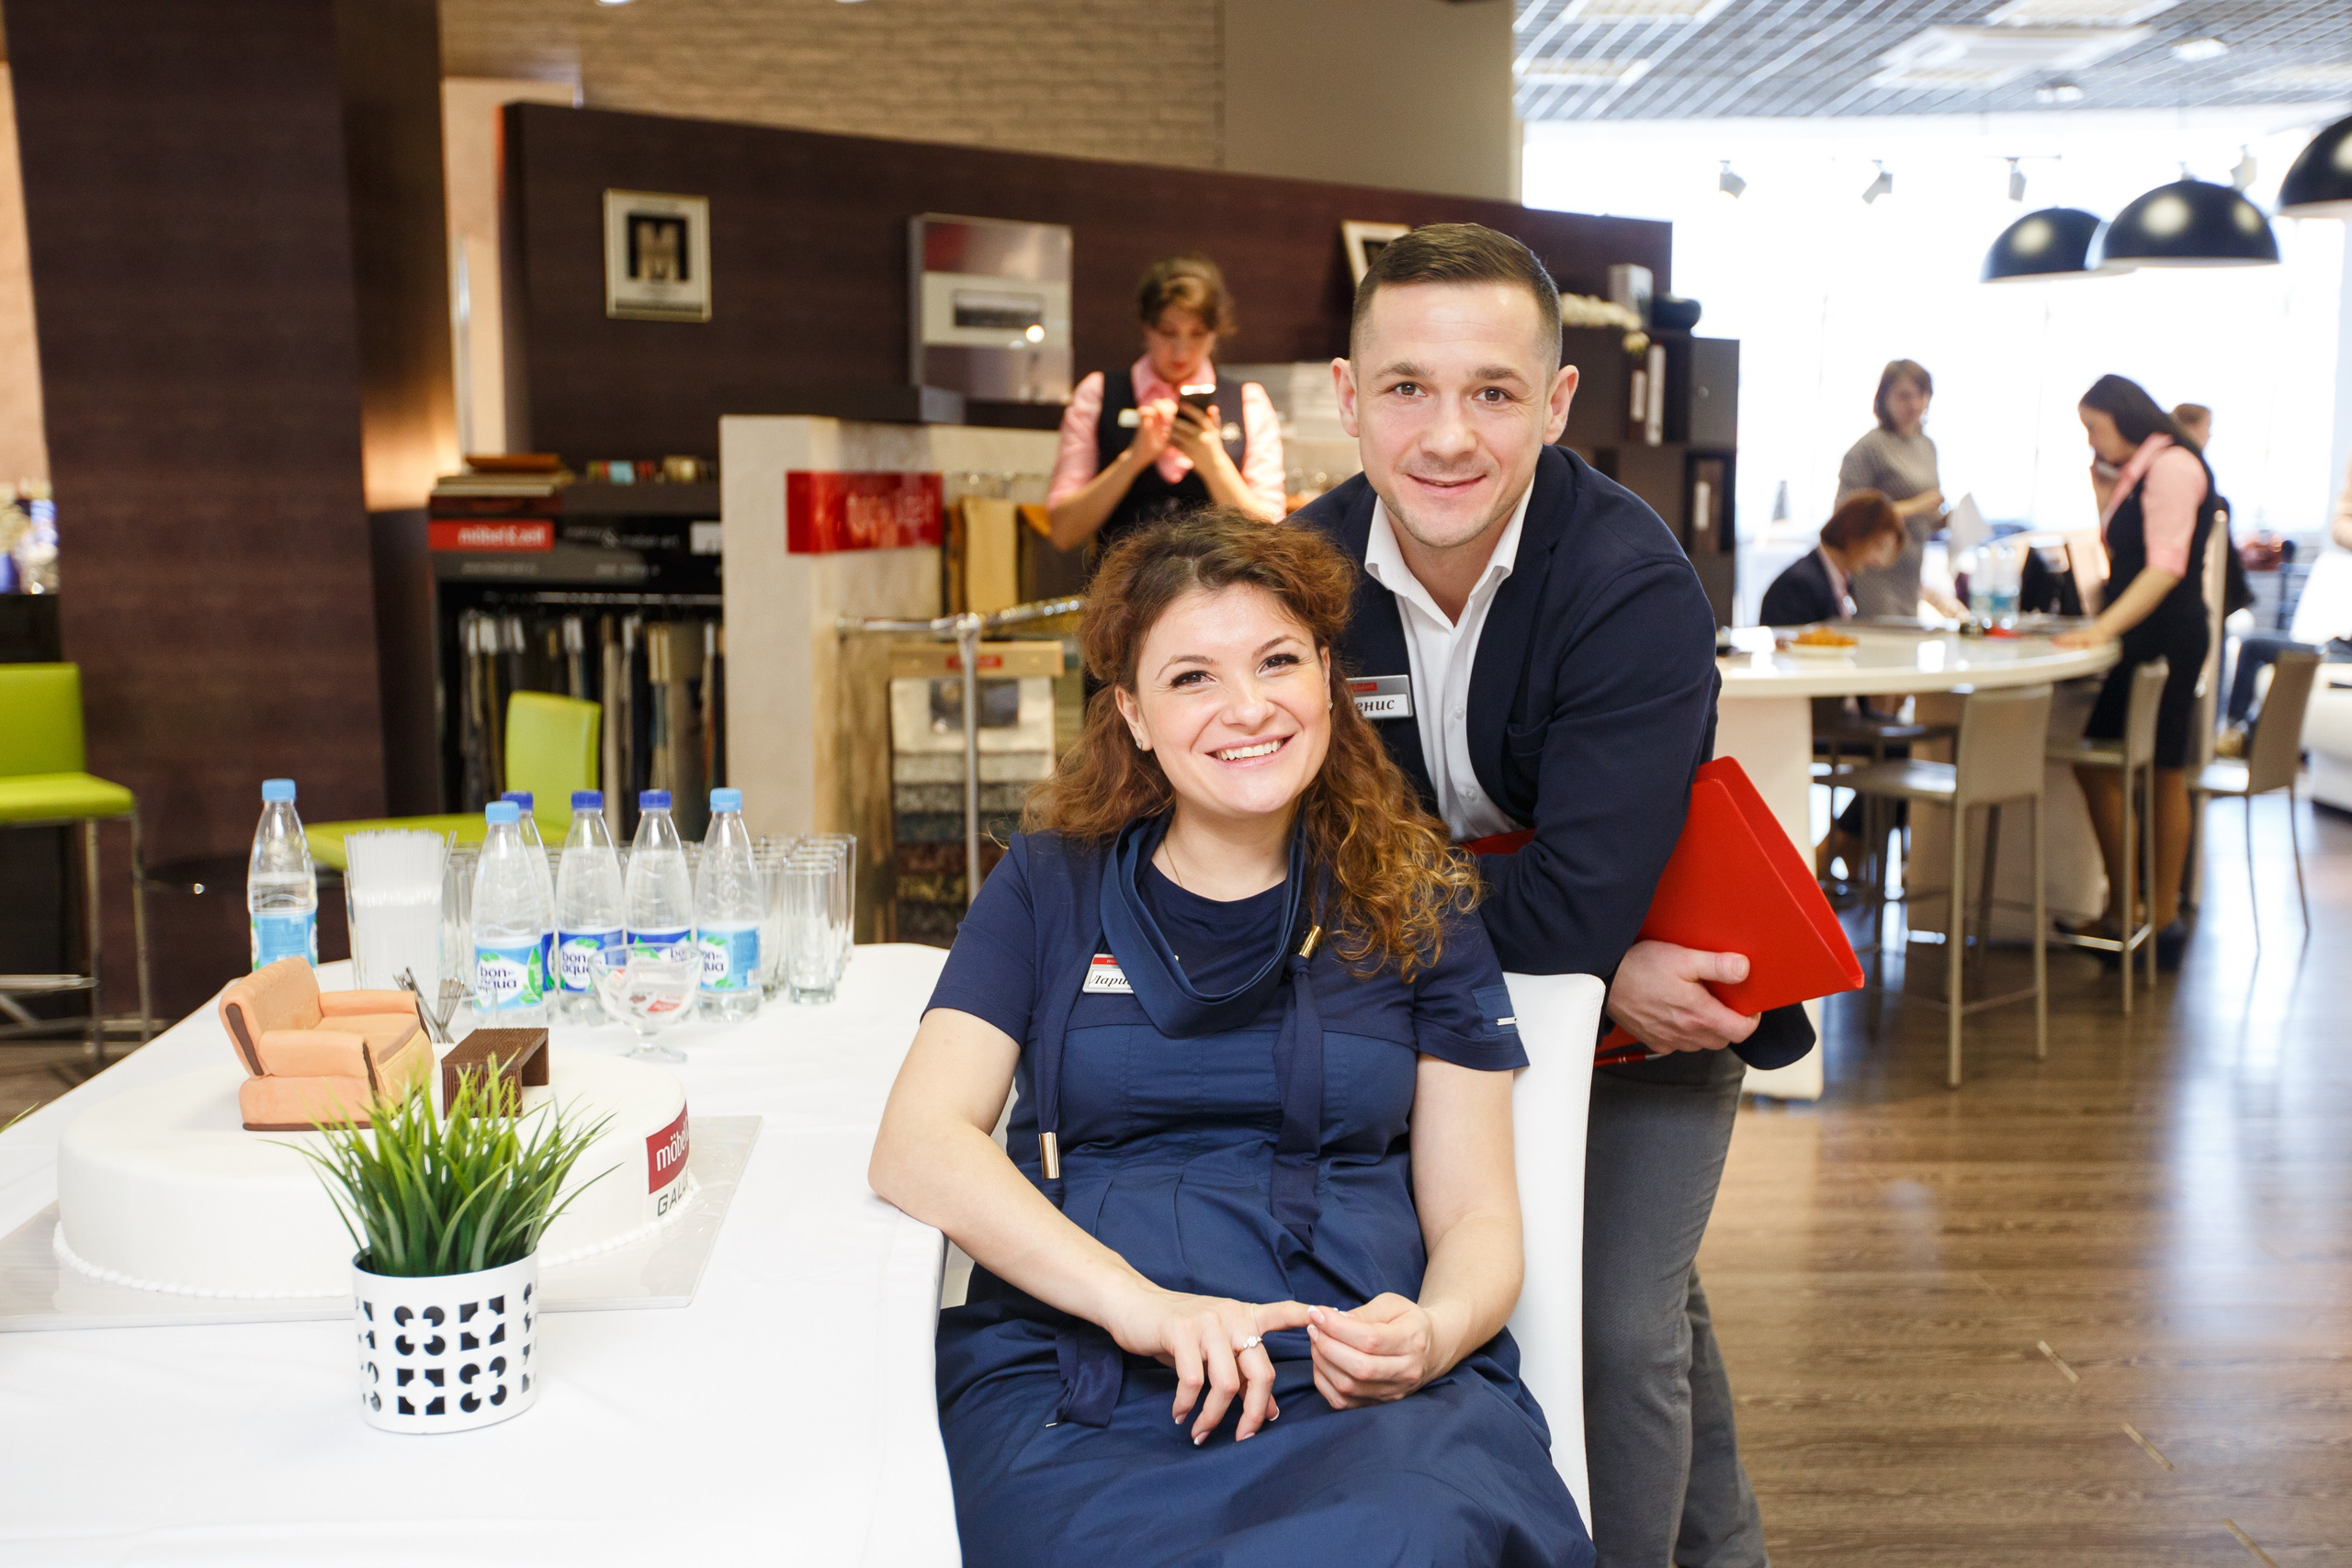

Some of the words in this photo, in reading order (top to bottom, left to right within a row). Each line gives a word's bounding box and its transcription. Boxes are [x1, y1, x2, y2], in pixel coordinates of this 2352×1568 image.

[1356, 699, 1396, 712] енис
[562, 949, 586, 963] bon
[562, 964, 588, 976] aqu
[1089, 975, 1130, 987] Лари
[658, 1166, 689, 1217] GALL
